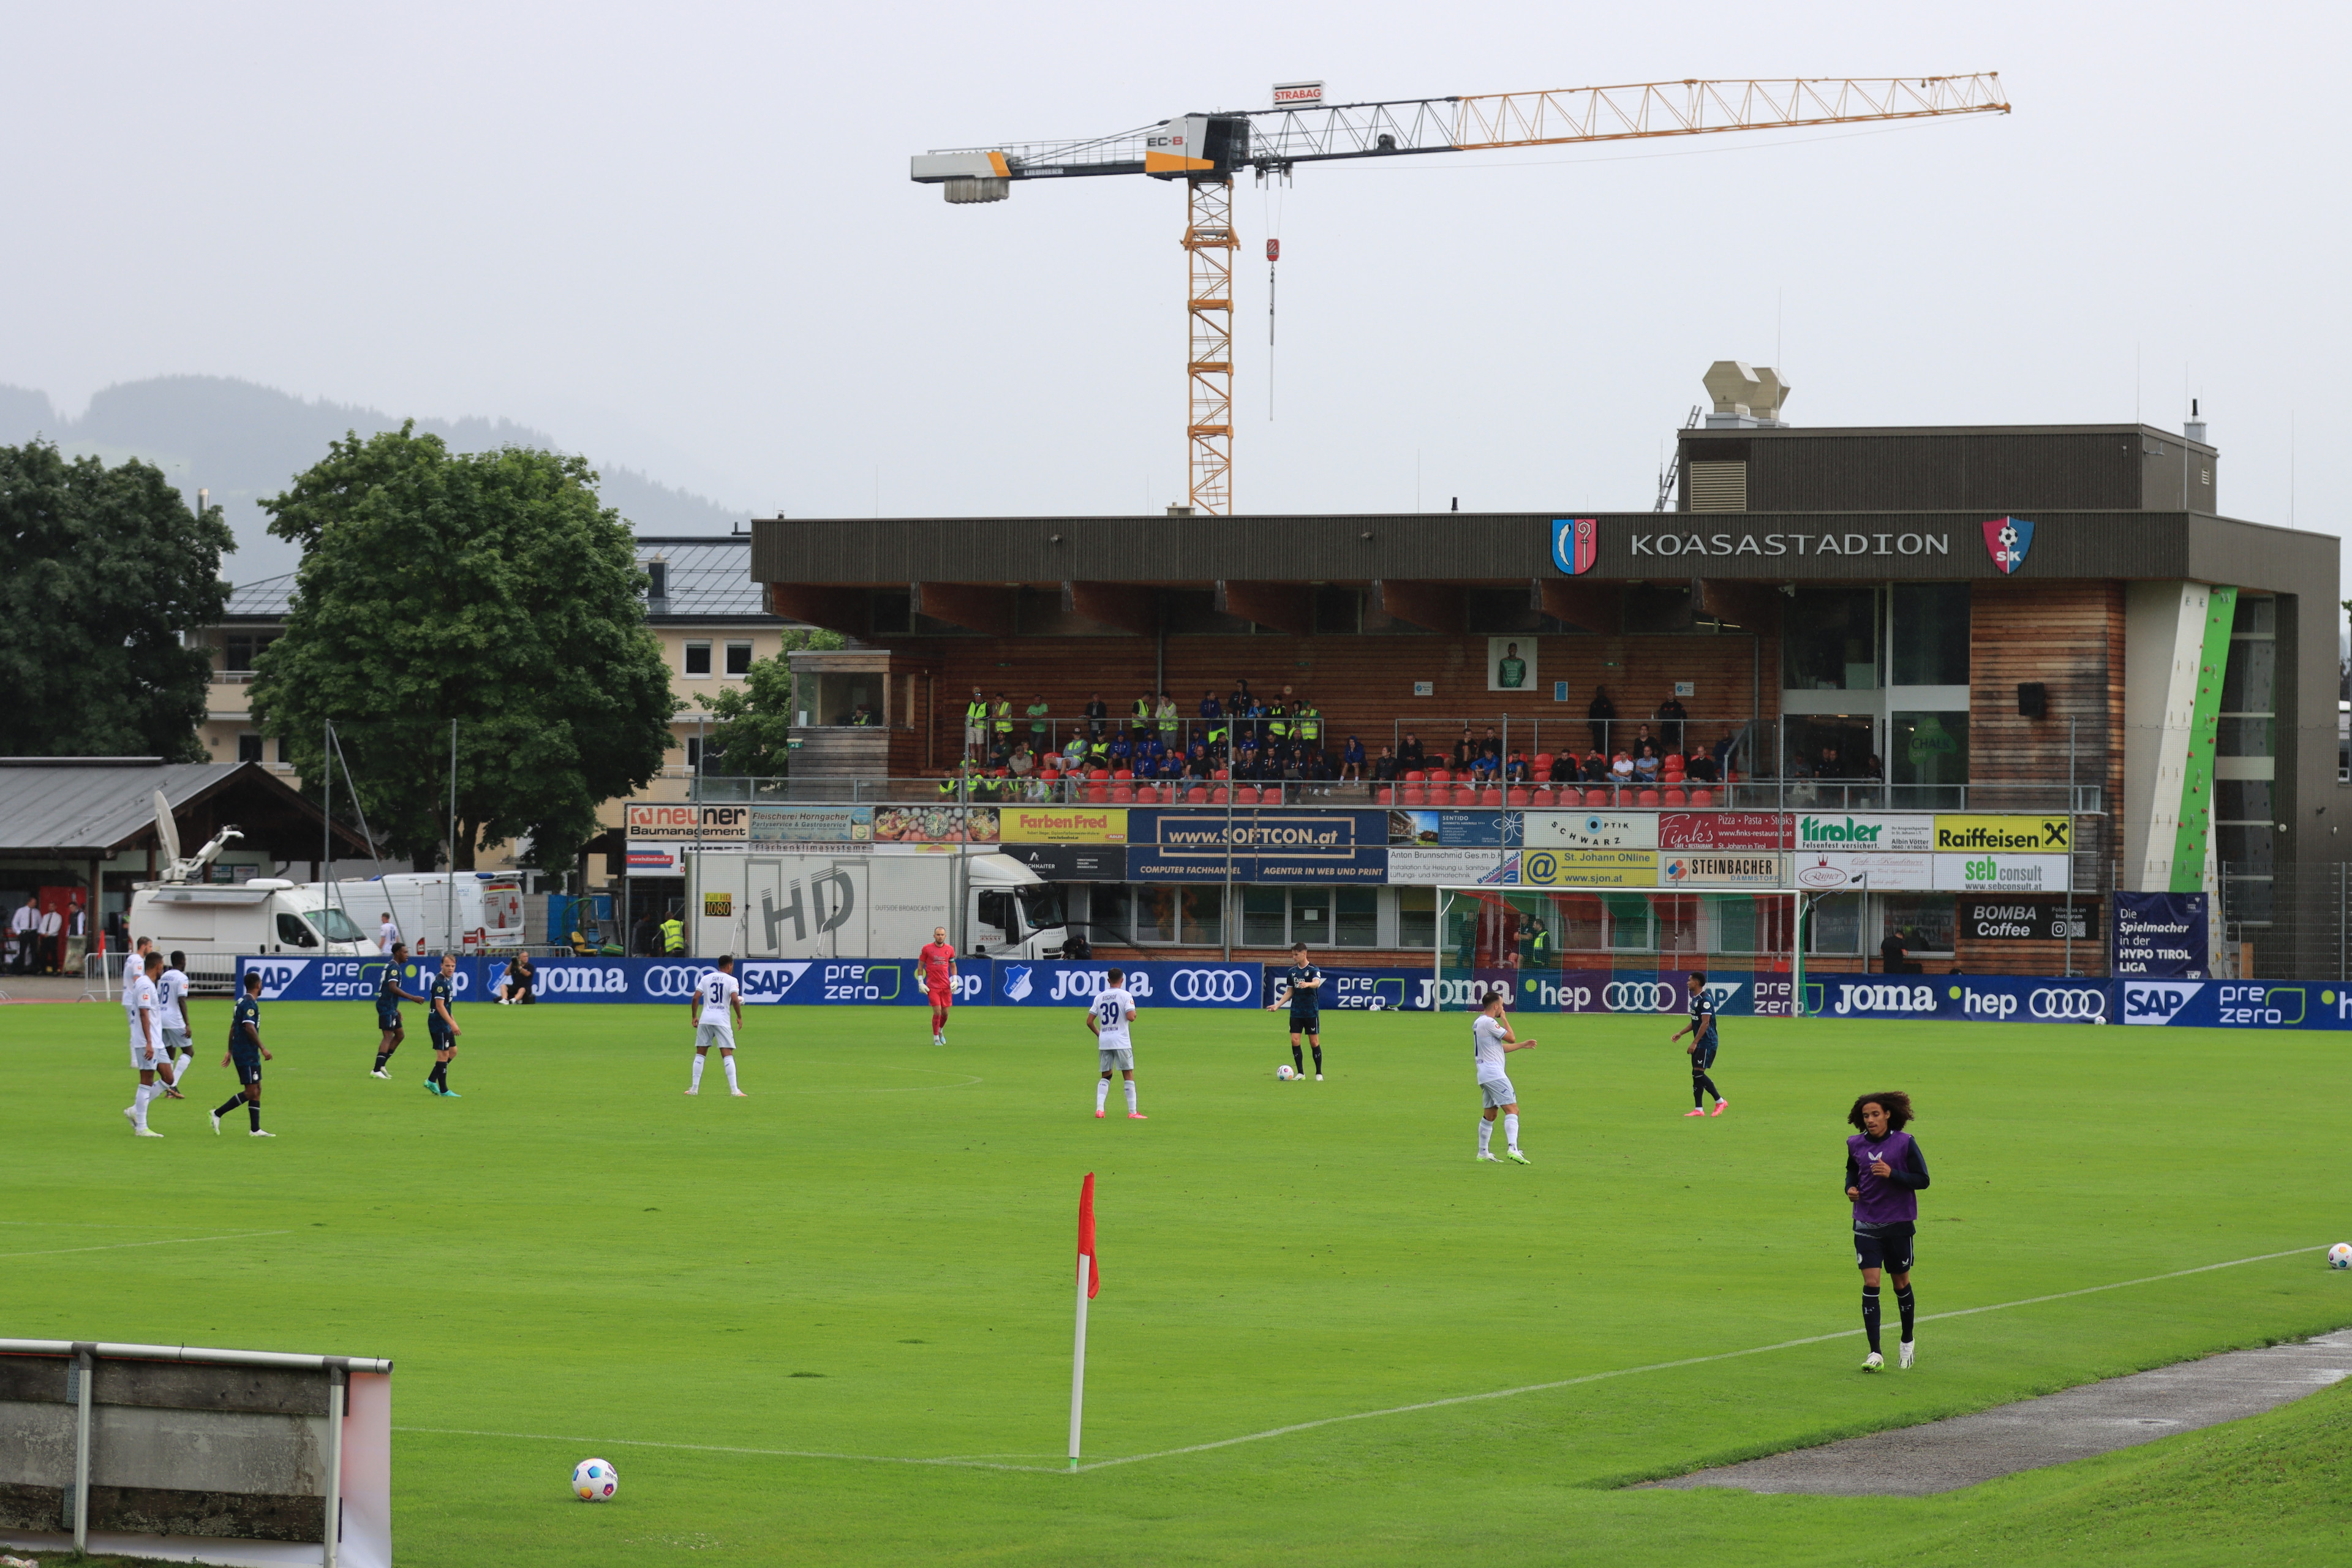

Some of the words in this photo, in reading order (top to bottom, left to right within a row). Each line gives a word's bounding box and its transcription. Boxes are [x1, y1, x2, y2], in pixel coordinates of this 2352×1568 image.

[1275, 89, 1322, 100] STRABAG
[1147, 136, 1183, 147] EC-B
[1632, 533, 1948, 556] KOASASTADION
[1996, 551, 2021, 562] SK
[657, 807, 746, 825] neuner
[800, 813, 849, 821] Horngacher
[1020, 814, 1073, 829] Farben
[1074, 815, 1107, 829] Fred
[1718, 815, 1735, 825] Pizza
[1744, 815, 1762, 825] Pasta
[631, 826, 746, 837] Baumanagement
[1169, 827, 1338, 845] www.SOFTCON.at
[1551, 821, 1621, 845] SCHWARZ
[1801, 815, 1882, 842] tiroler
[1939, 827, 2040, 848] Raiffeisen
[1564, 853, 1577, 862] St.
[1582, 853, 1615, 862] Johann
[1618, 853, 1650, 862] ONline
[1692, 859, 1773, 875] STEINBACHER
[1965, 856, 1997, 881] seb
[1999, 865, 2043, 881] consult
[1564, 874, 1623, 884] www.sjon.at
[1965, 883, 2043, 891] www.sebconsult.at
[706, 902, 730, 915] 1080
[761, 867, 854, 951] HD
[1973, 905, 2037, 920] BOMBA
[2120, 908, 2138, 919] Die
[1977, 922, 2030, 937] Coffee
[2120, 922, 2190, 935] Spielmacher
[2120, 935, 2130, 945] in
[2133, 935, 2150, 945] der
[2120, 949, 2153, 959] HYPO
[2157, 949, 2192, 960] TIROL
[322, 962, 360, 980] pre
[824, 965, 865, 983] pre
[2120, 962, 2147, 973] LIGA
[321, 982, 373, 996] zero
[419, 965, 469, 997] hp
[744, 970, 794, 995] SAP
[1337, 977, 1374, 993] pre
[710, 982, 724, 1003] 31
[824, 985, 880, 1000] zero
[1540, 980, 1592, 1012] hep
[1754, 982, 1792, 998] pre
[2219, 986, 2265, 1005] pre
[1337, 995, 1386, 1008] zero
[1964, 987, 2018, 1019] hep
[2126, 989, 2184, 1017] SAP
[1100, 1001, 1119, 1025] 39
[2219, 1008, 2282, 1024] zero
